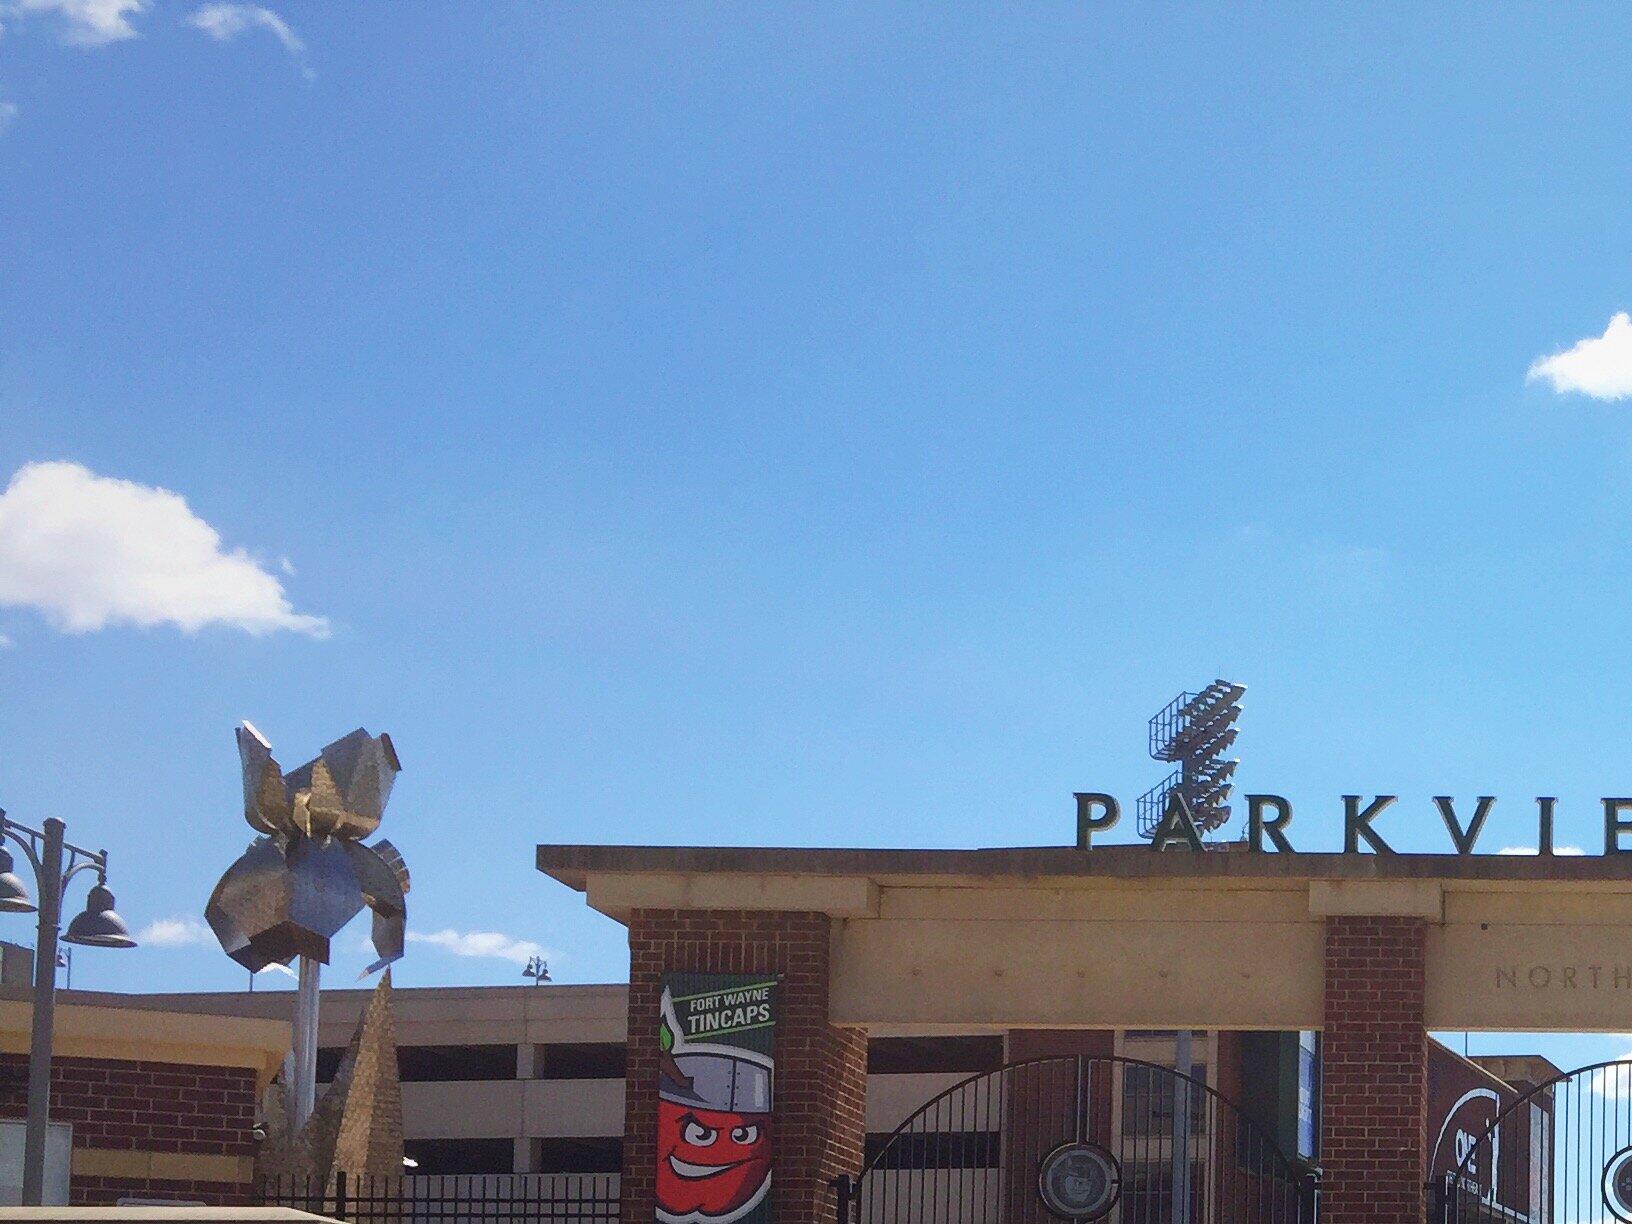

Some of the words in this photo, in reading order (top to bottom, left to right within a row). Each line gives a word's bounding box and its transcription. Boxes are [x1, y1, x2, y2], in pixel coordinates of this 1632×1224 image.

[1495, 966, 1632, 989] NORTH
[690, 996, 721, 1012] FORT
[723, 988, 770, 1006] WAYNE
[687, 1003, 771, 1034] TINCAPS
